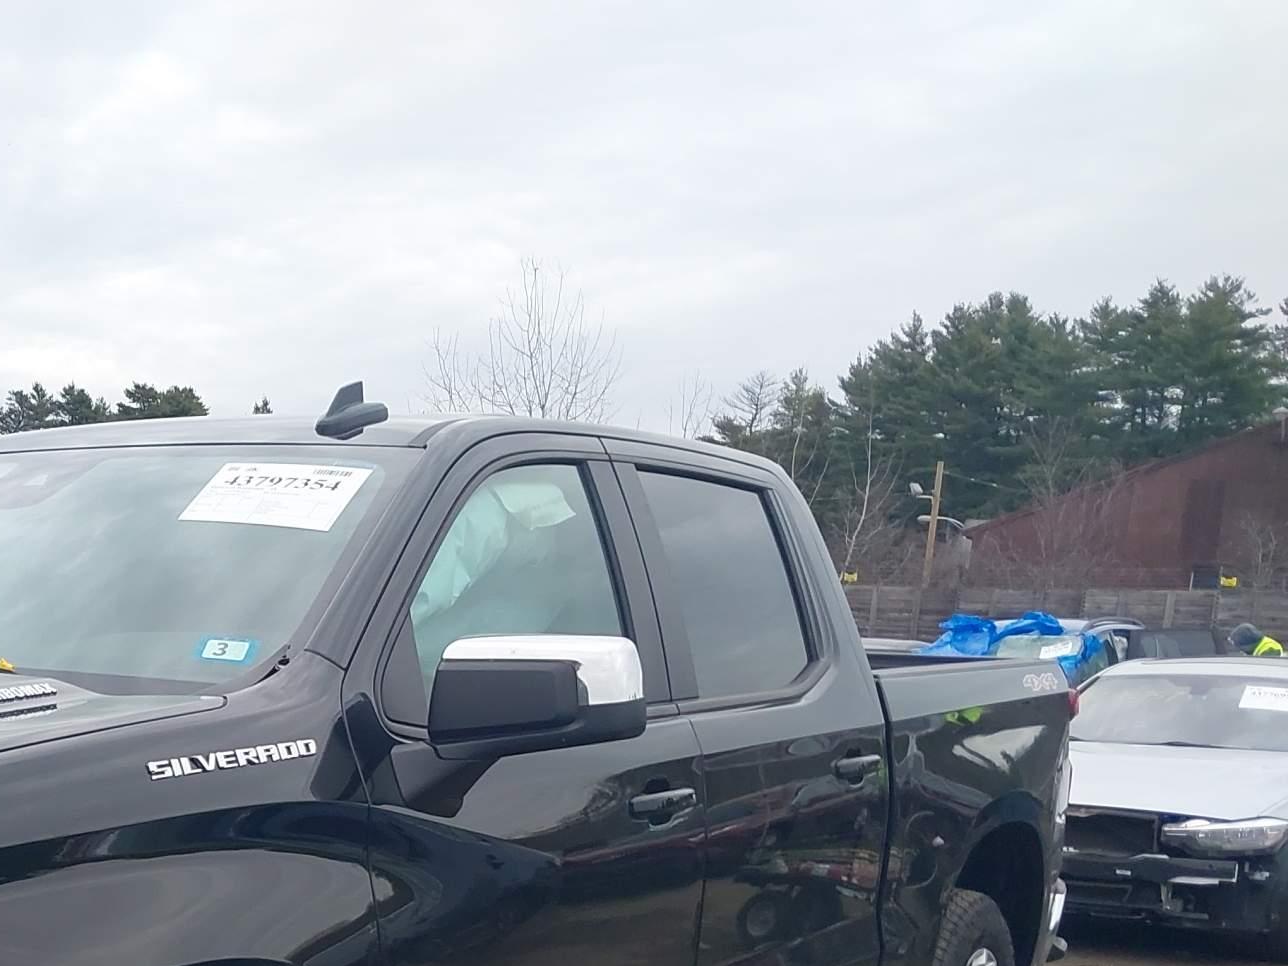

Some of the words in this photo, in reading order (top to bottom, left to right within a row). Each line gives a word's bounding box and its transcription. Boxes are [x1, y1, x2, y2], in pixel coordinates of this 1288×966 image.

[224, 475, 342, 491] 43797354
[212, 642, 229, 656] 3
[146, 739, 317, 780] SILVERADO
